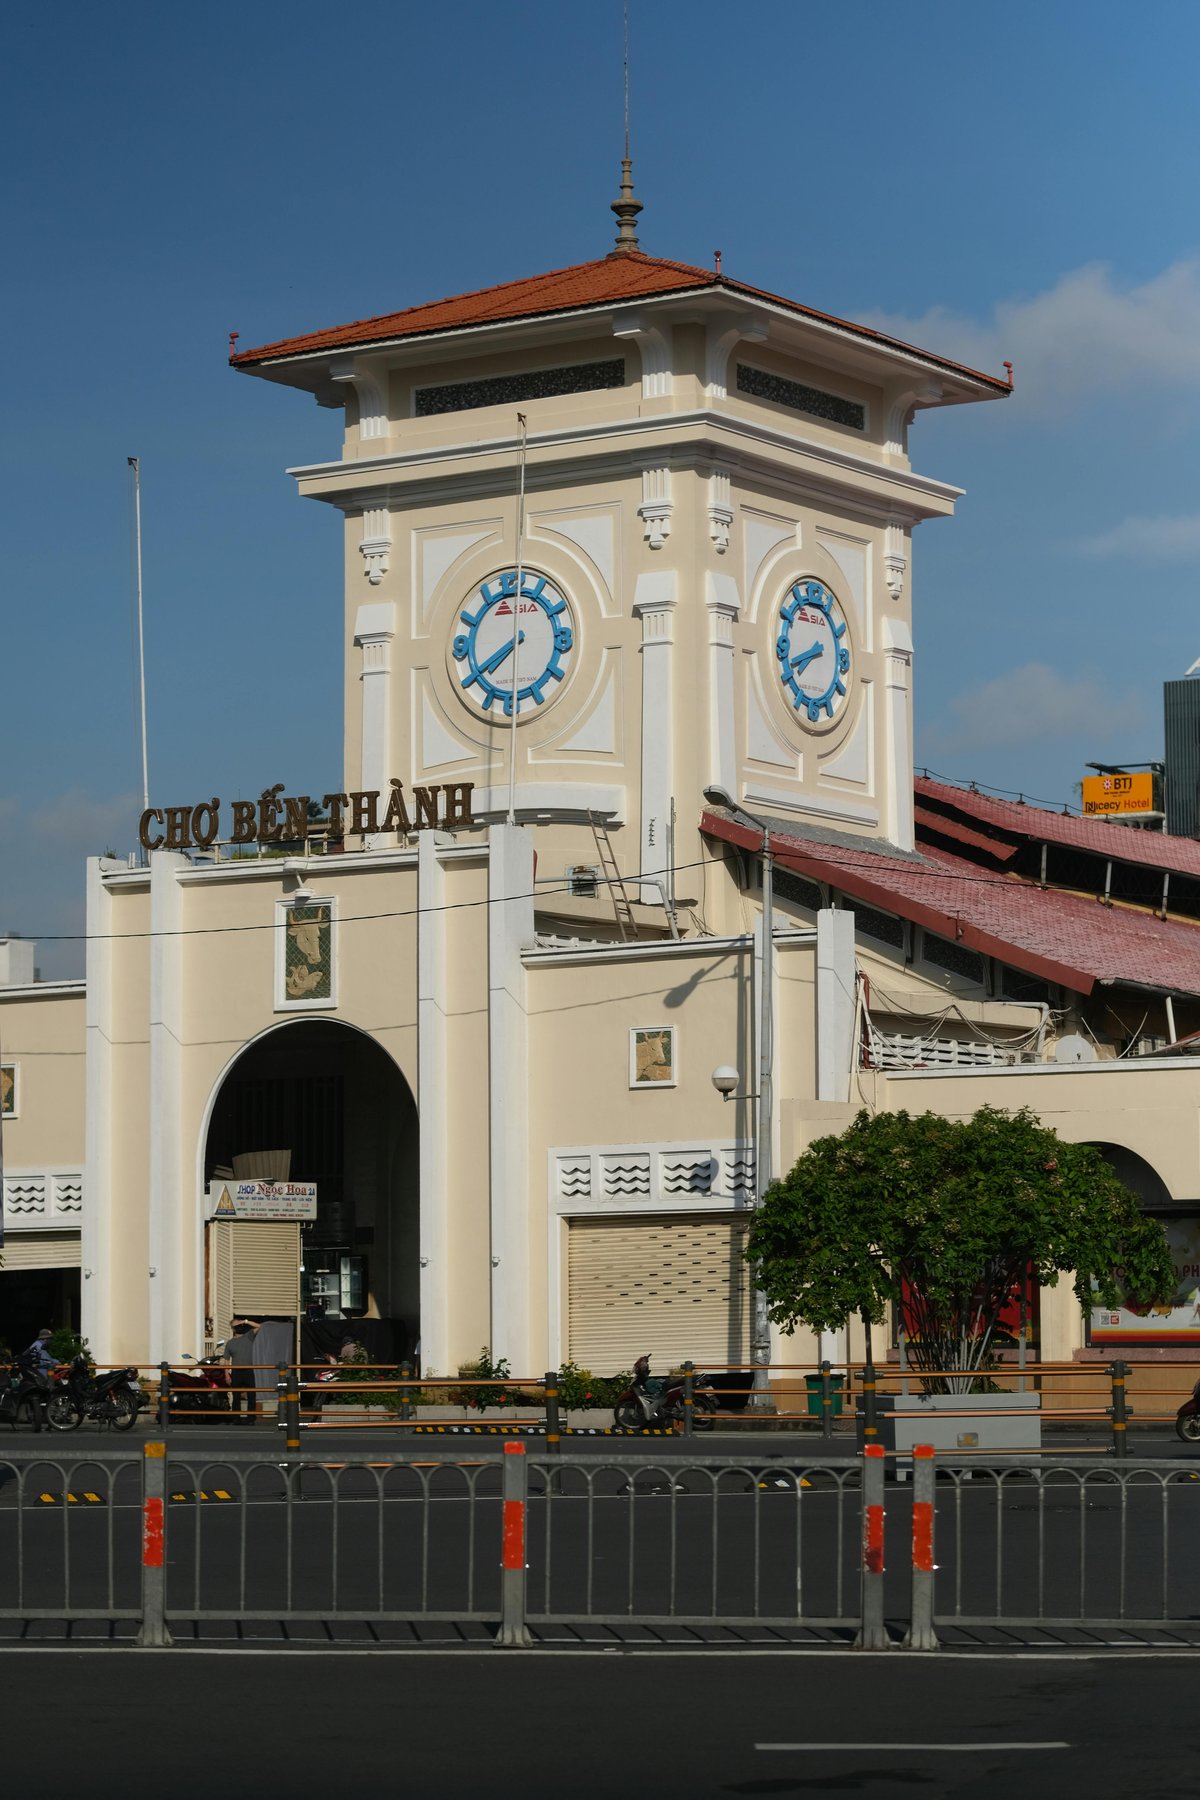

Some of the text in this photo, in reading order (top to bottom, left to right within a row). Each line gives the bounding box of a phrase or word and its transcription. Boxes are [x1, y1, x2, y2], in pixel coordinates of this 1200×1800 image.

[500, 572, 526, 594] 12
[452, 635, 469, 657] 9
[776, 636, 790, 658] 9
[1114, 778, 1132, 790] BTJ
[1124, 798, 1150, 808] Hotel
[139, 778, 475, 851] CHỢ BẾN THÀNH
[237, 1184, 255, 1194] SHOP
[257, 1184, 283, 1197] Ngọc
[286, 1184, 307, 1195] Hoa
